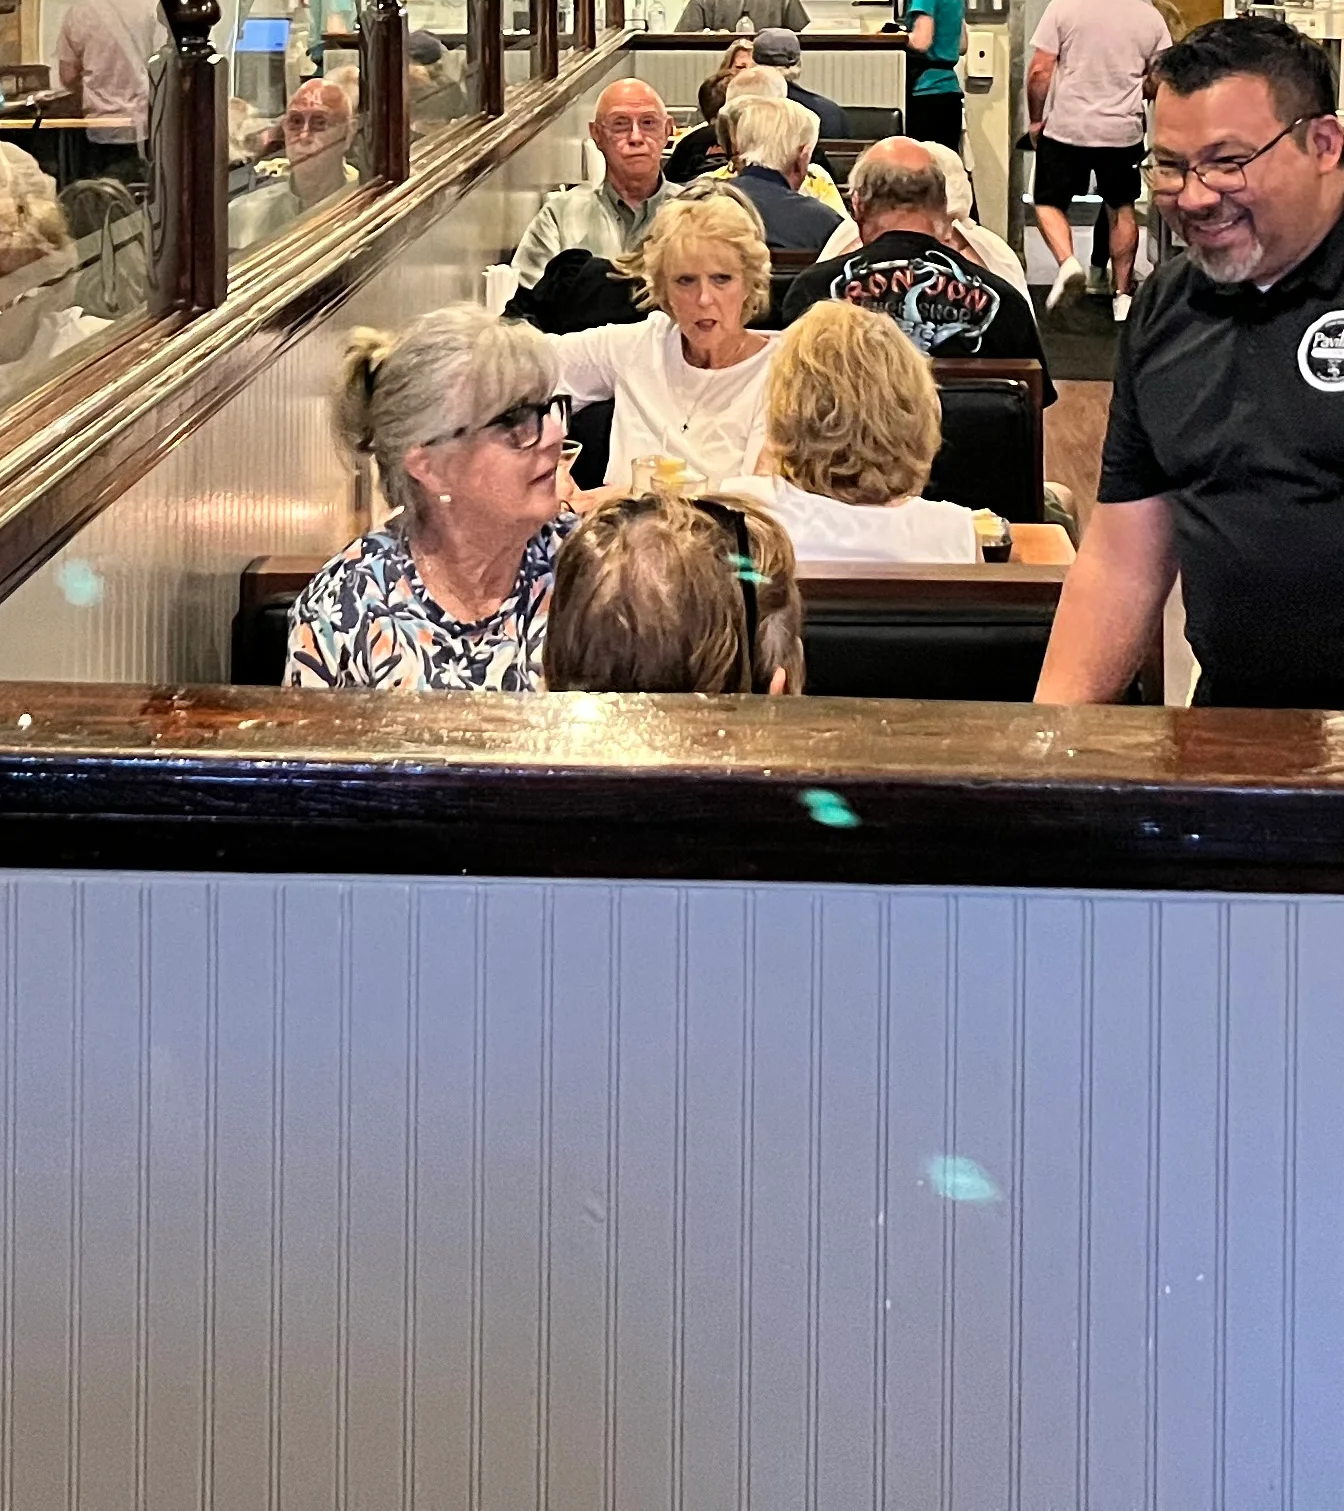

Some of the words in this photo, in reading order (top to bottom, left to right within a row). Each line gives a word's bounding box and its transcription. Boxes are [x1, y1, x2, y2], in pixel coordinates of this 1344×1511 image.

[844, 268, 914, 303] RON
[924, 275, 990, 312] JON
[919, 302, 972, 323] SHOP
